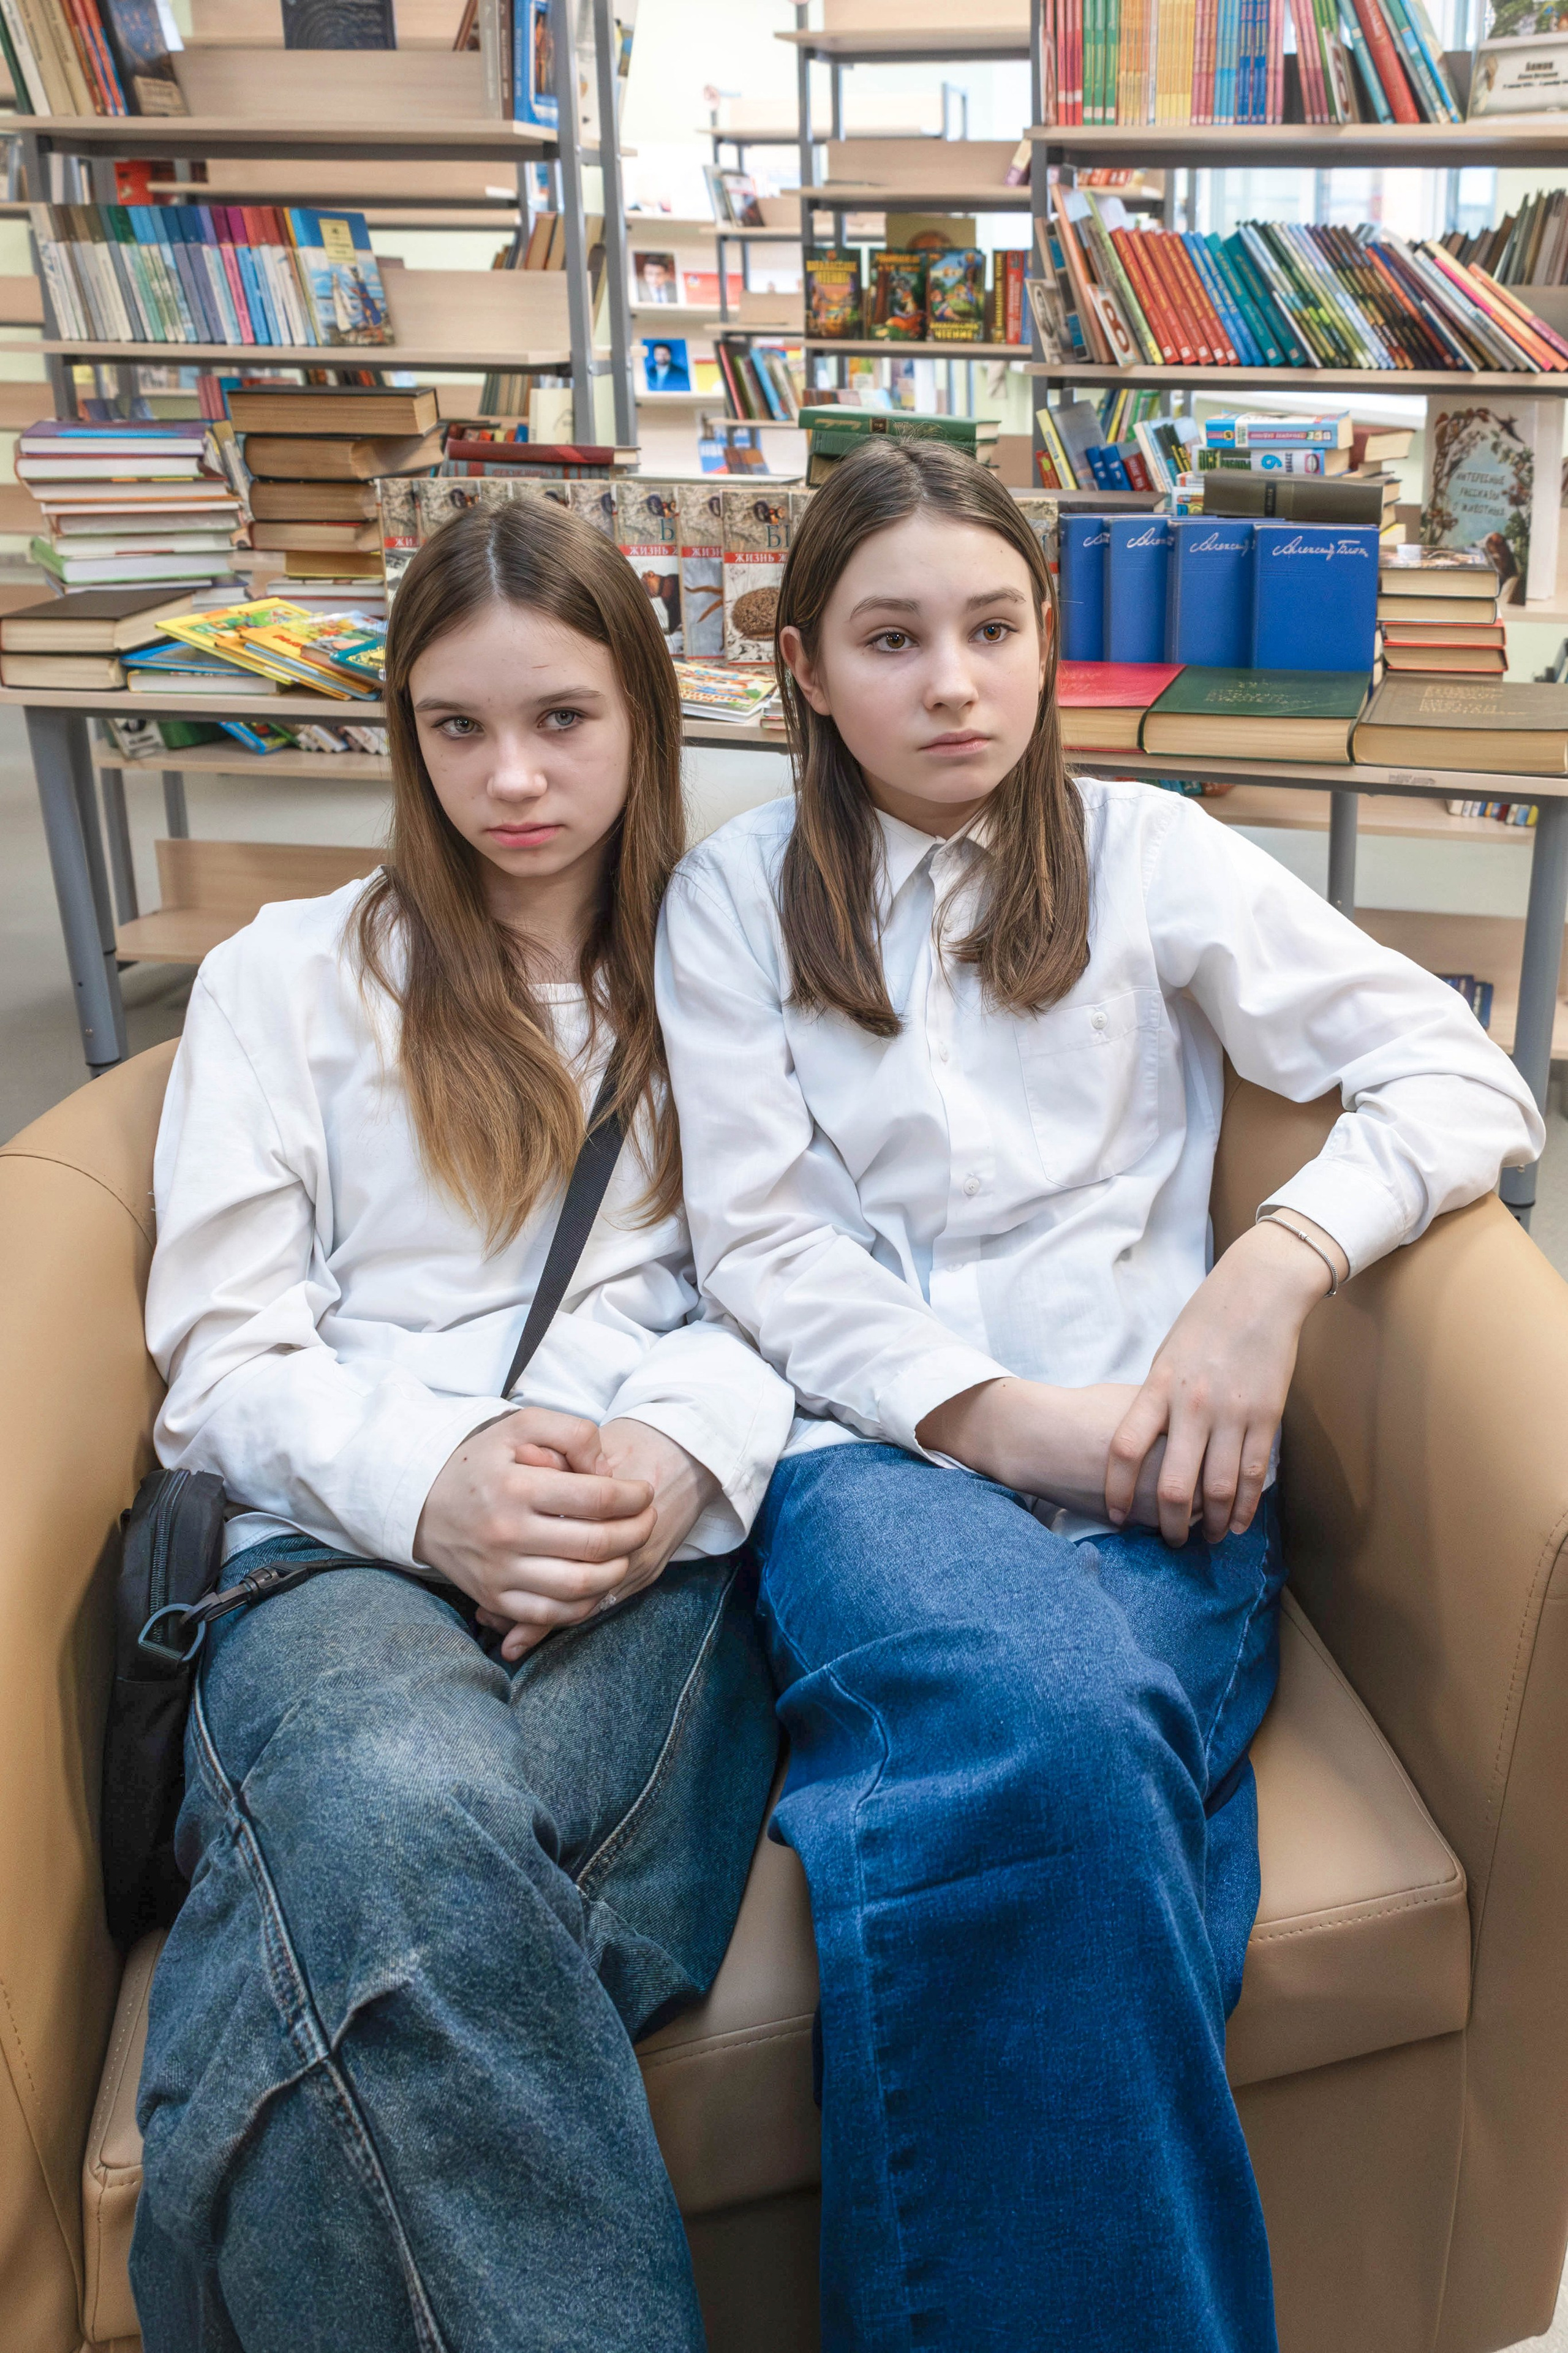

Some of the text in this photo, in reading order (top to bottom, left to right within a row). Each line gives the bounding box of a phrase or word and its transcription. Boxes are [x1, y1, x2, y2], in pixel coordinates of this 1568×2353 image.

[629, 545, 669, 556] ЖИЗНЬ
[692, 546, 722, 557] ЖИЗН
[735, 552, 774, 562] ЖИЗНЬ
